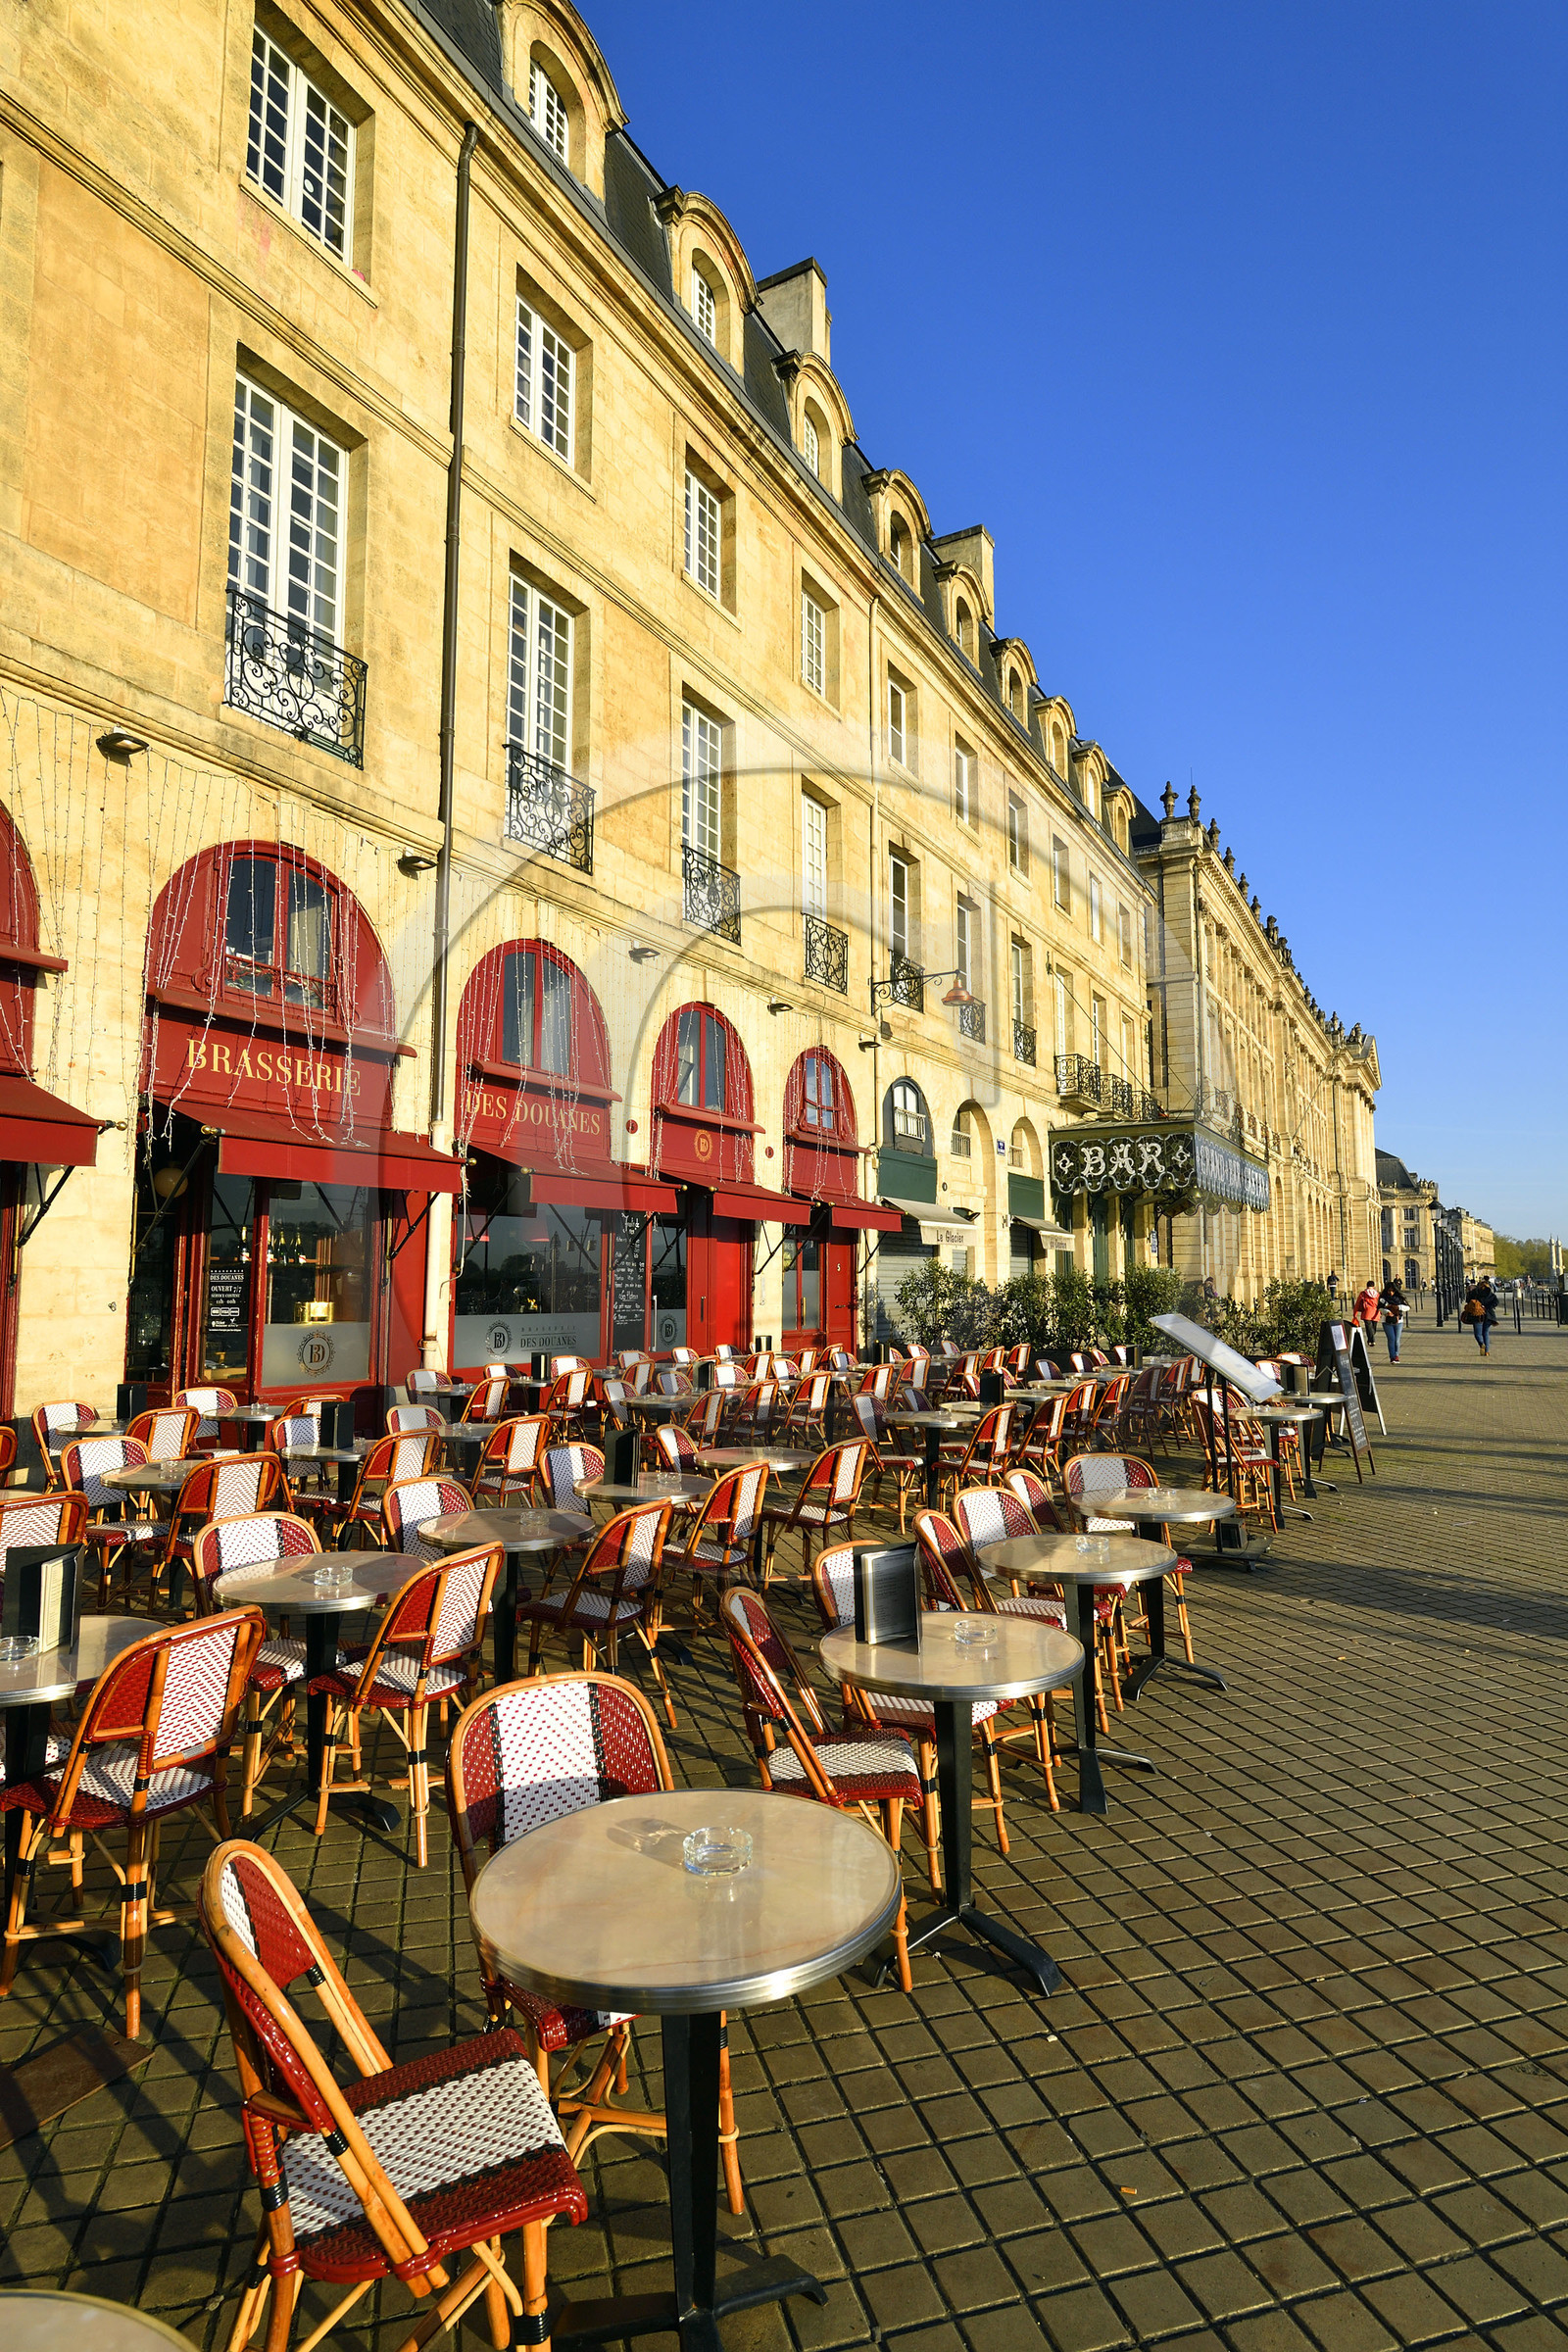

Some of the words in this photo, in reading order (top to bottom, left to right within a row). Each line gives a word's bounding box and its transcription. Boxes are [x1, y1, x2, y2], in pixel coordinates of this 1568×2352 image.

[186, 1039, 361, 1096] BRASSERIE
[466, 1090, 507, 1119] DES
[515, 1100, 601, 1135] DOUANES
[1080, 1143, 1165, 1177] BAR
[936, 1229, 943, 1242] Le
[946, 1230, 964, 1243] Glacier
[837, 1263, 841, 1272] 5
[520, 1337, 537, 1348] DES
[539, 1335, 577, 1348] DOUANES
